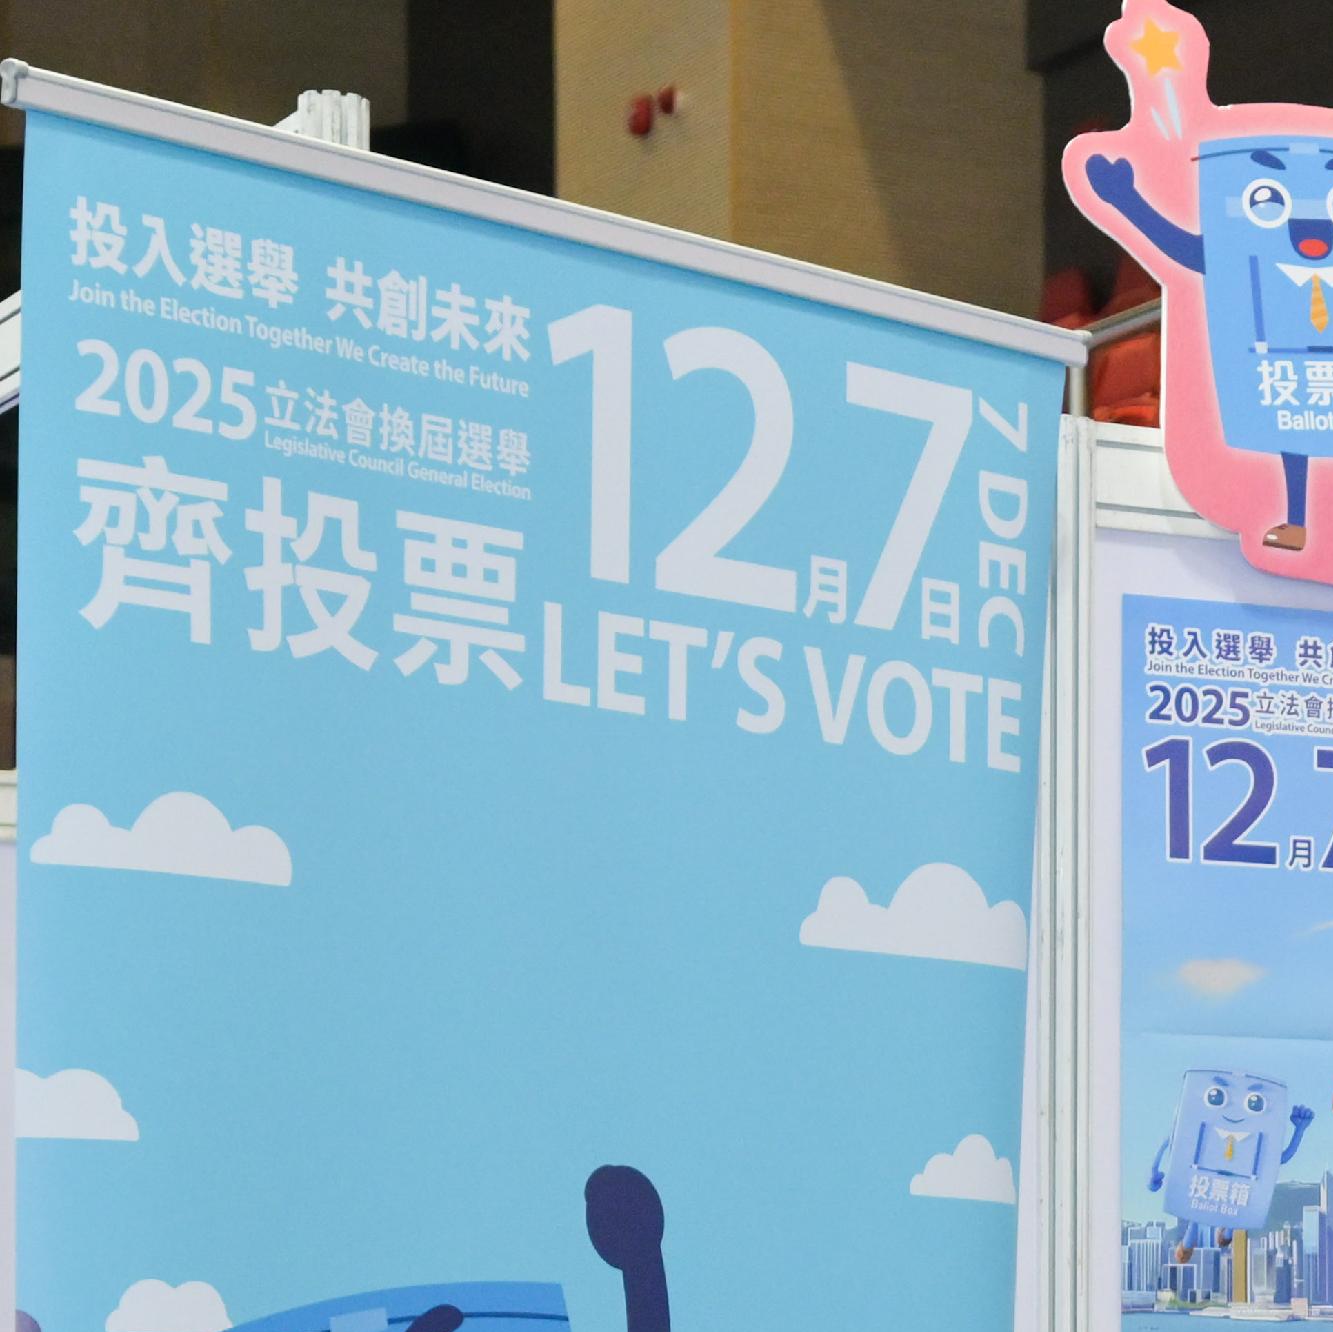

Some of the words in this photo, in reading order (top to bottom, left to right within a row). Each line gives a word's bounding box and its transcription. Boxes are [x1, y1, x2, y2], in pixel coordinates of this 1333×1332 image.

[69, 196, 299, 309] 投入選舉
[325, 256, 531, 362] 共創未來
[69, 279, 116, 309] Join
[120, 291, 155, 316] the
[160, 297, 242, 335] Election
[247, 314, 333, 356] Together
[336, 336, 365, 363] We
[367, 344, 430, 378] Create
[434, 359, 464, 385] the
[468, 364, 529, 398] Future
[977, 396, 1027, 453] 7
[264, 430, 346, 464] Legislative
[348, 448, 403, 478] Council
[407, 462, 467, 490] General
[470, 472, 532, 501] Election
[75, 455, 527, 693] 齊投票
[977, 469, 1027, 657] DEC
[1147, 661, 1172, 673] Join
[1176, 664, 1194, 674] the
[1198, 665, 1244, 678] Election
[1249, 669, 1298, 685] Together
[1302, 673, 1318, 684] We
[1148, 626, 1273, 664] 投入選舉
[804, 645, 1023, 774] VOTE
[1255, 722, 1304, 733] Legislative
[1187, 1174, 1250, 1207] 投票箱
